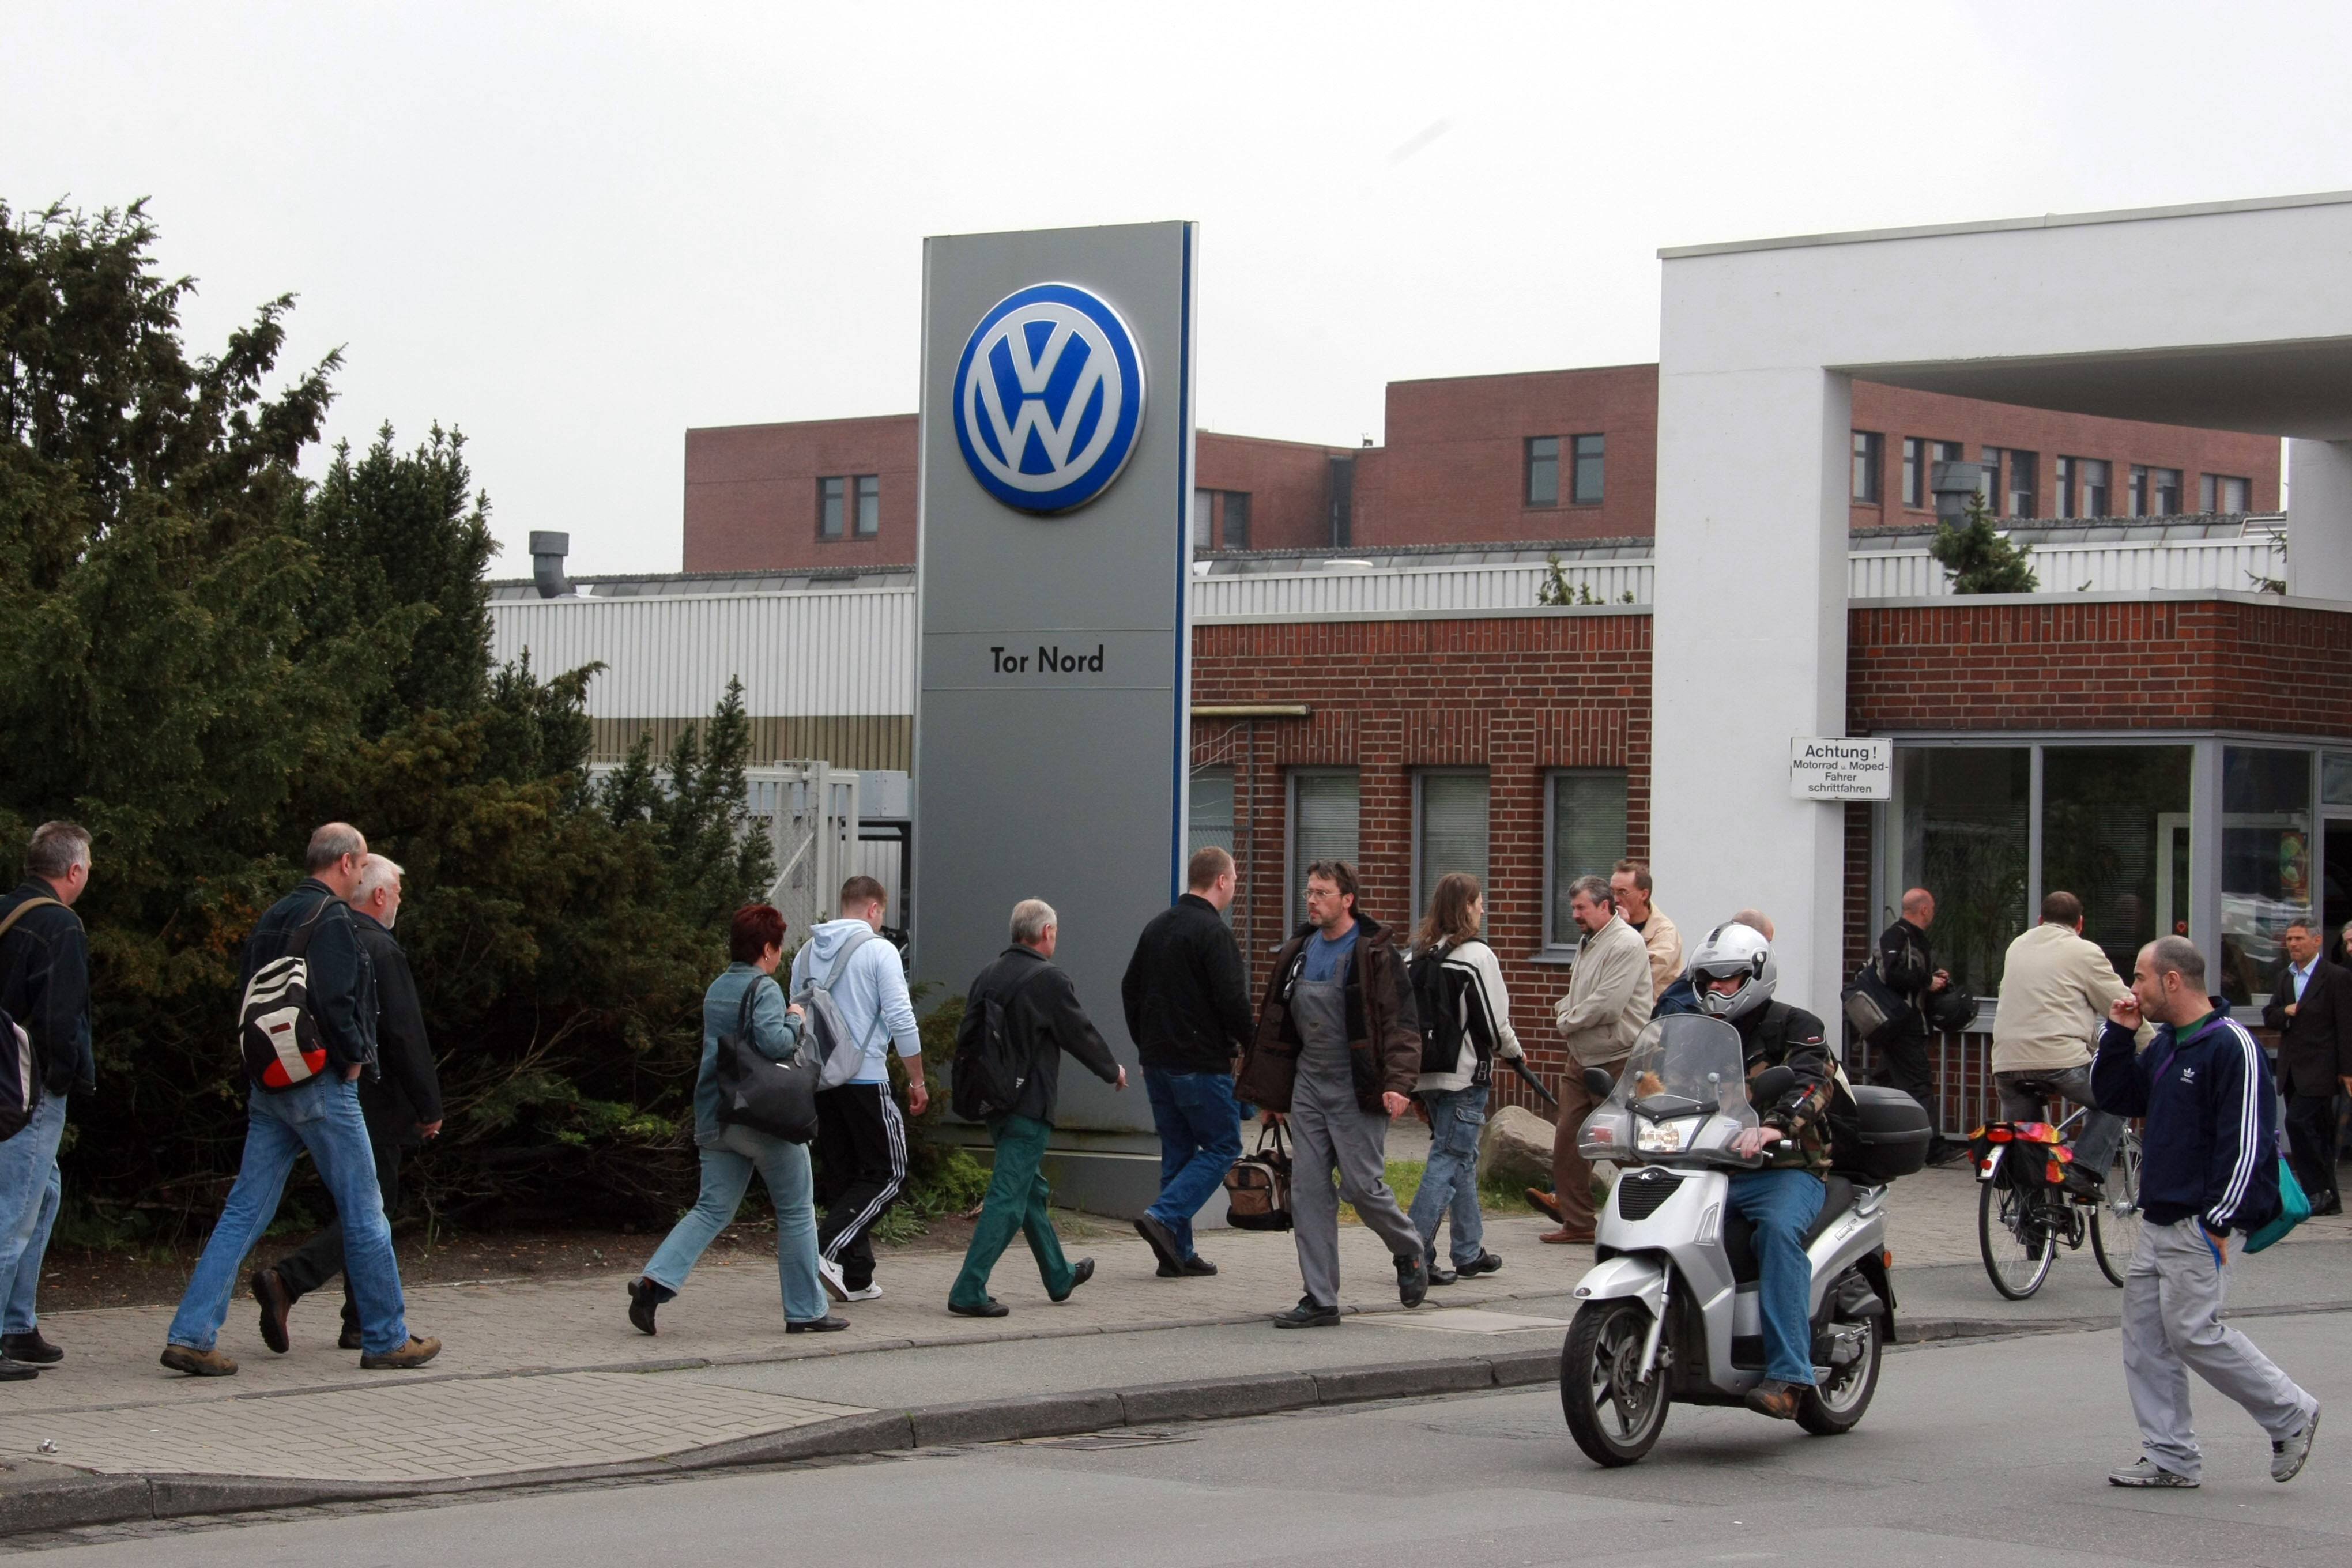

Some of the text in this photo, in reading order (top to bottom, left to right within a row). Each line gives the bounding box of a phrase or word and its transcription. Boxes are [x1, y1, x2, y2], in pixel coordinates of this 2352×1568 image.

[964, 302, 1122, 492] VW
[990, 644, 1103, 673] Tor Nord
[1793, 760, 1838, 770] Motorrad
[1825, 772, 1857, 782] Fahrer
[1808, 783, 1872, 793] schrittfahren
